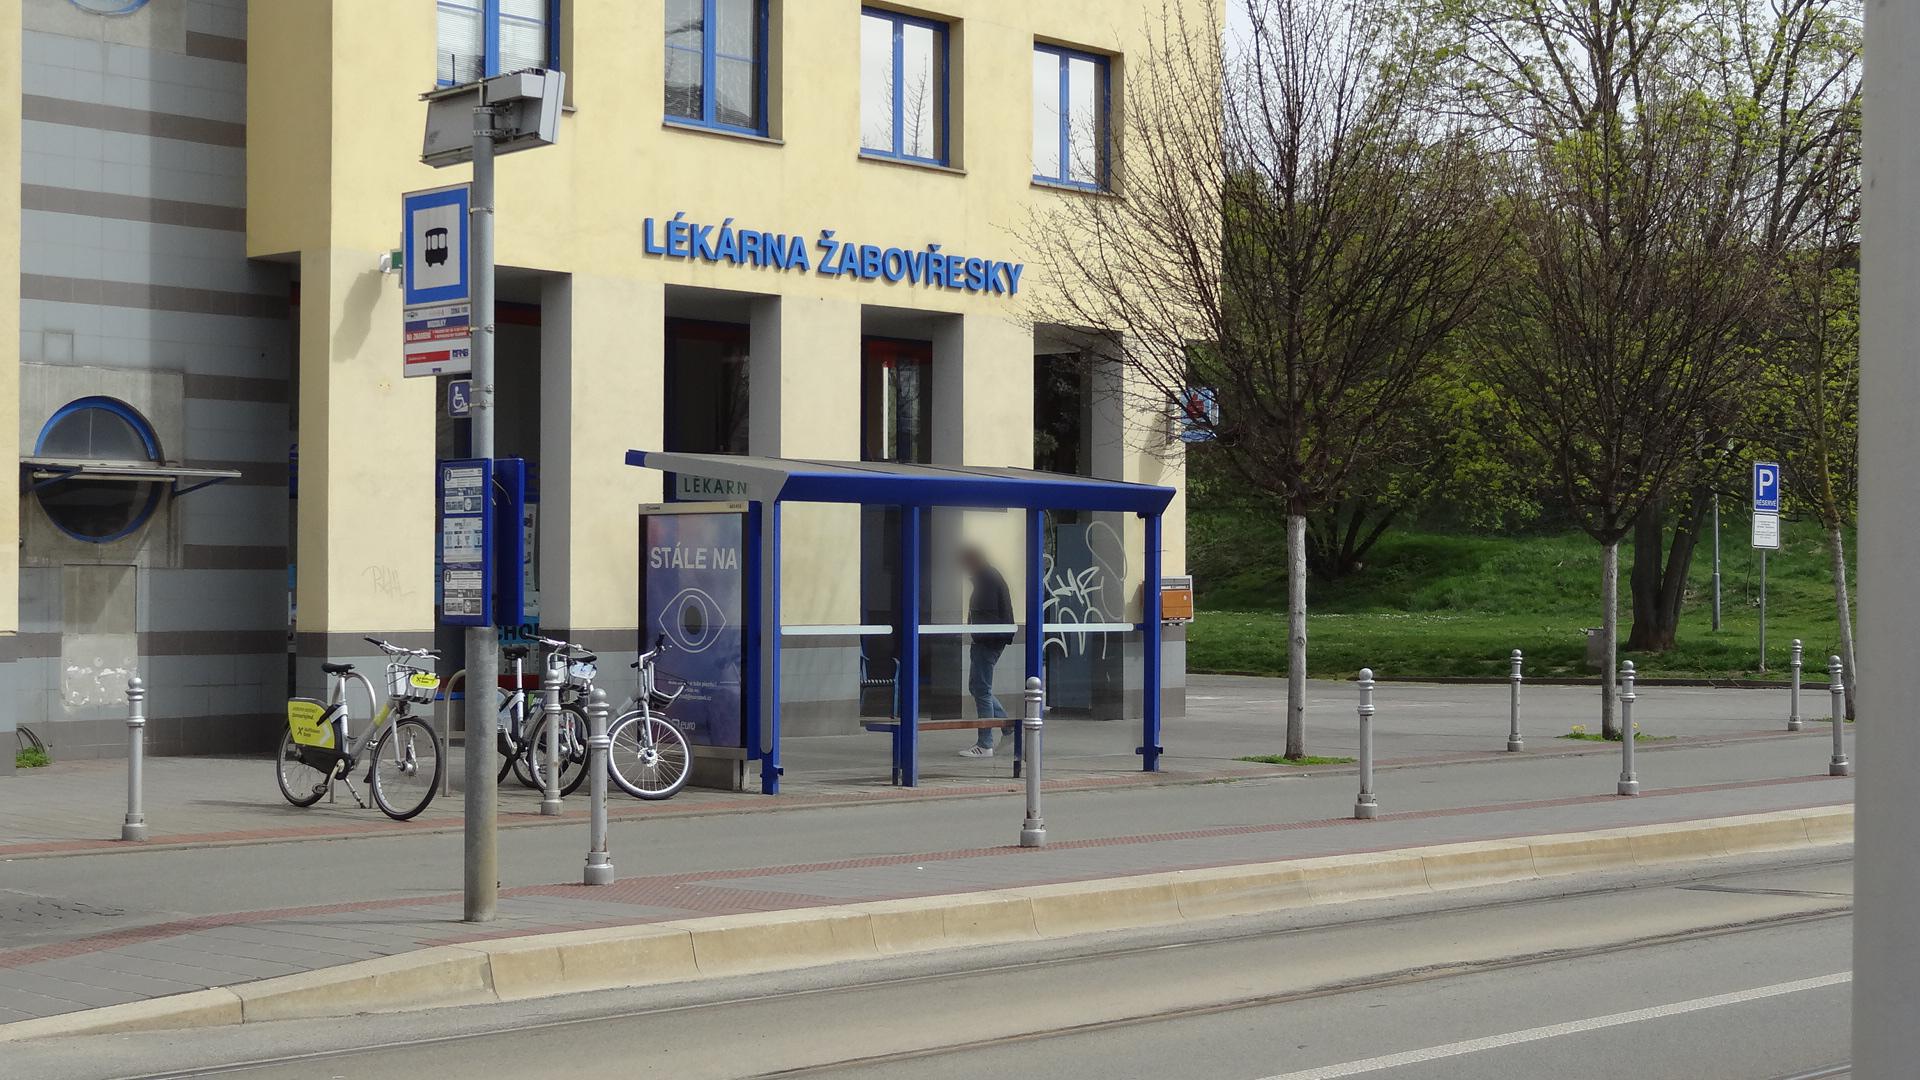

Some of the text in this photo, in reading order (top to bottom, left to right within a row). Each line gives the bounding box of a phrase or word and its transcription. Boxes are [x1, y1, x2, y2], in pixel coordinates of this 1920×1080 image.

[644, 212, 1024, 296] LÉKÁRNA ŽABOVŘESKY
[1759, 469, 1774, 496] P
[650, 541, 738, 570] STÁLE NA
